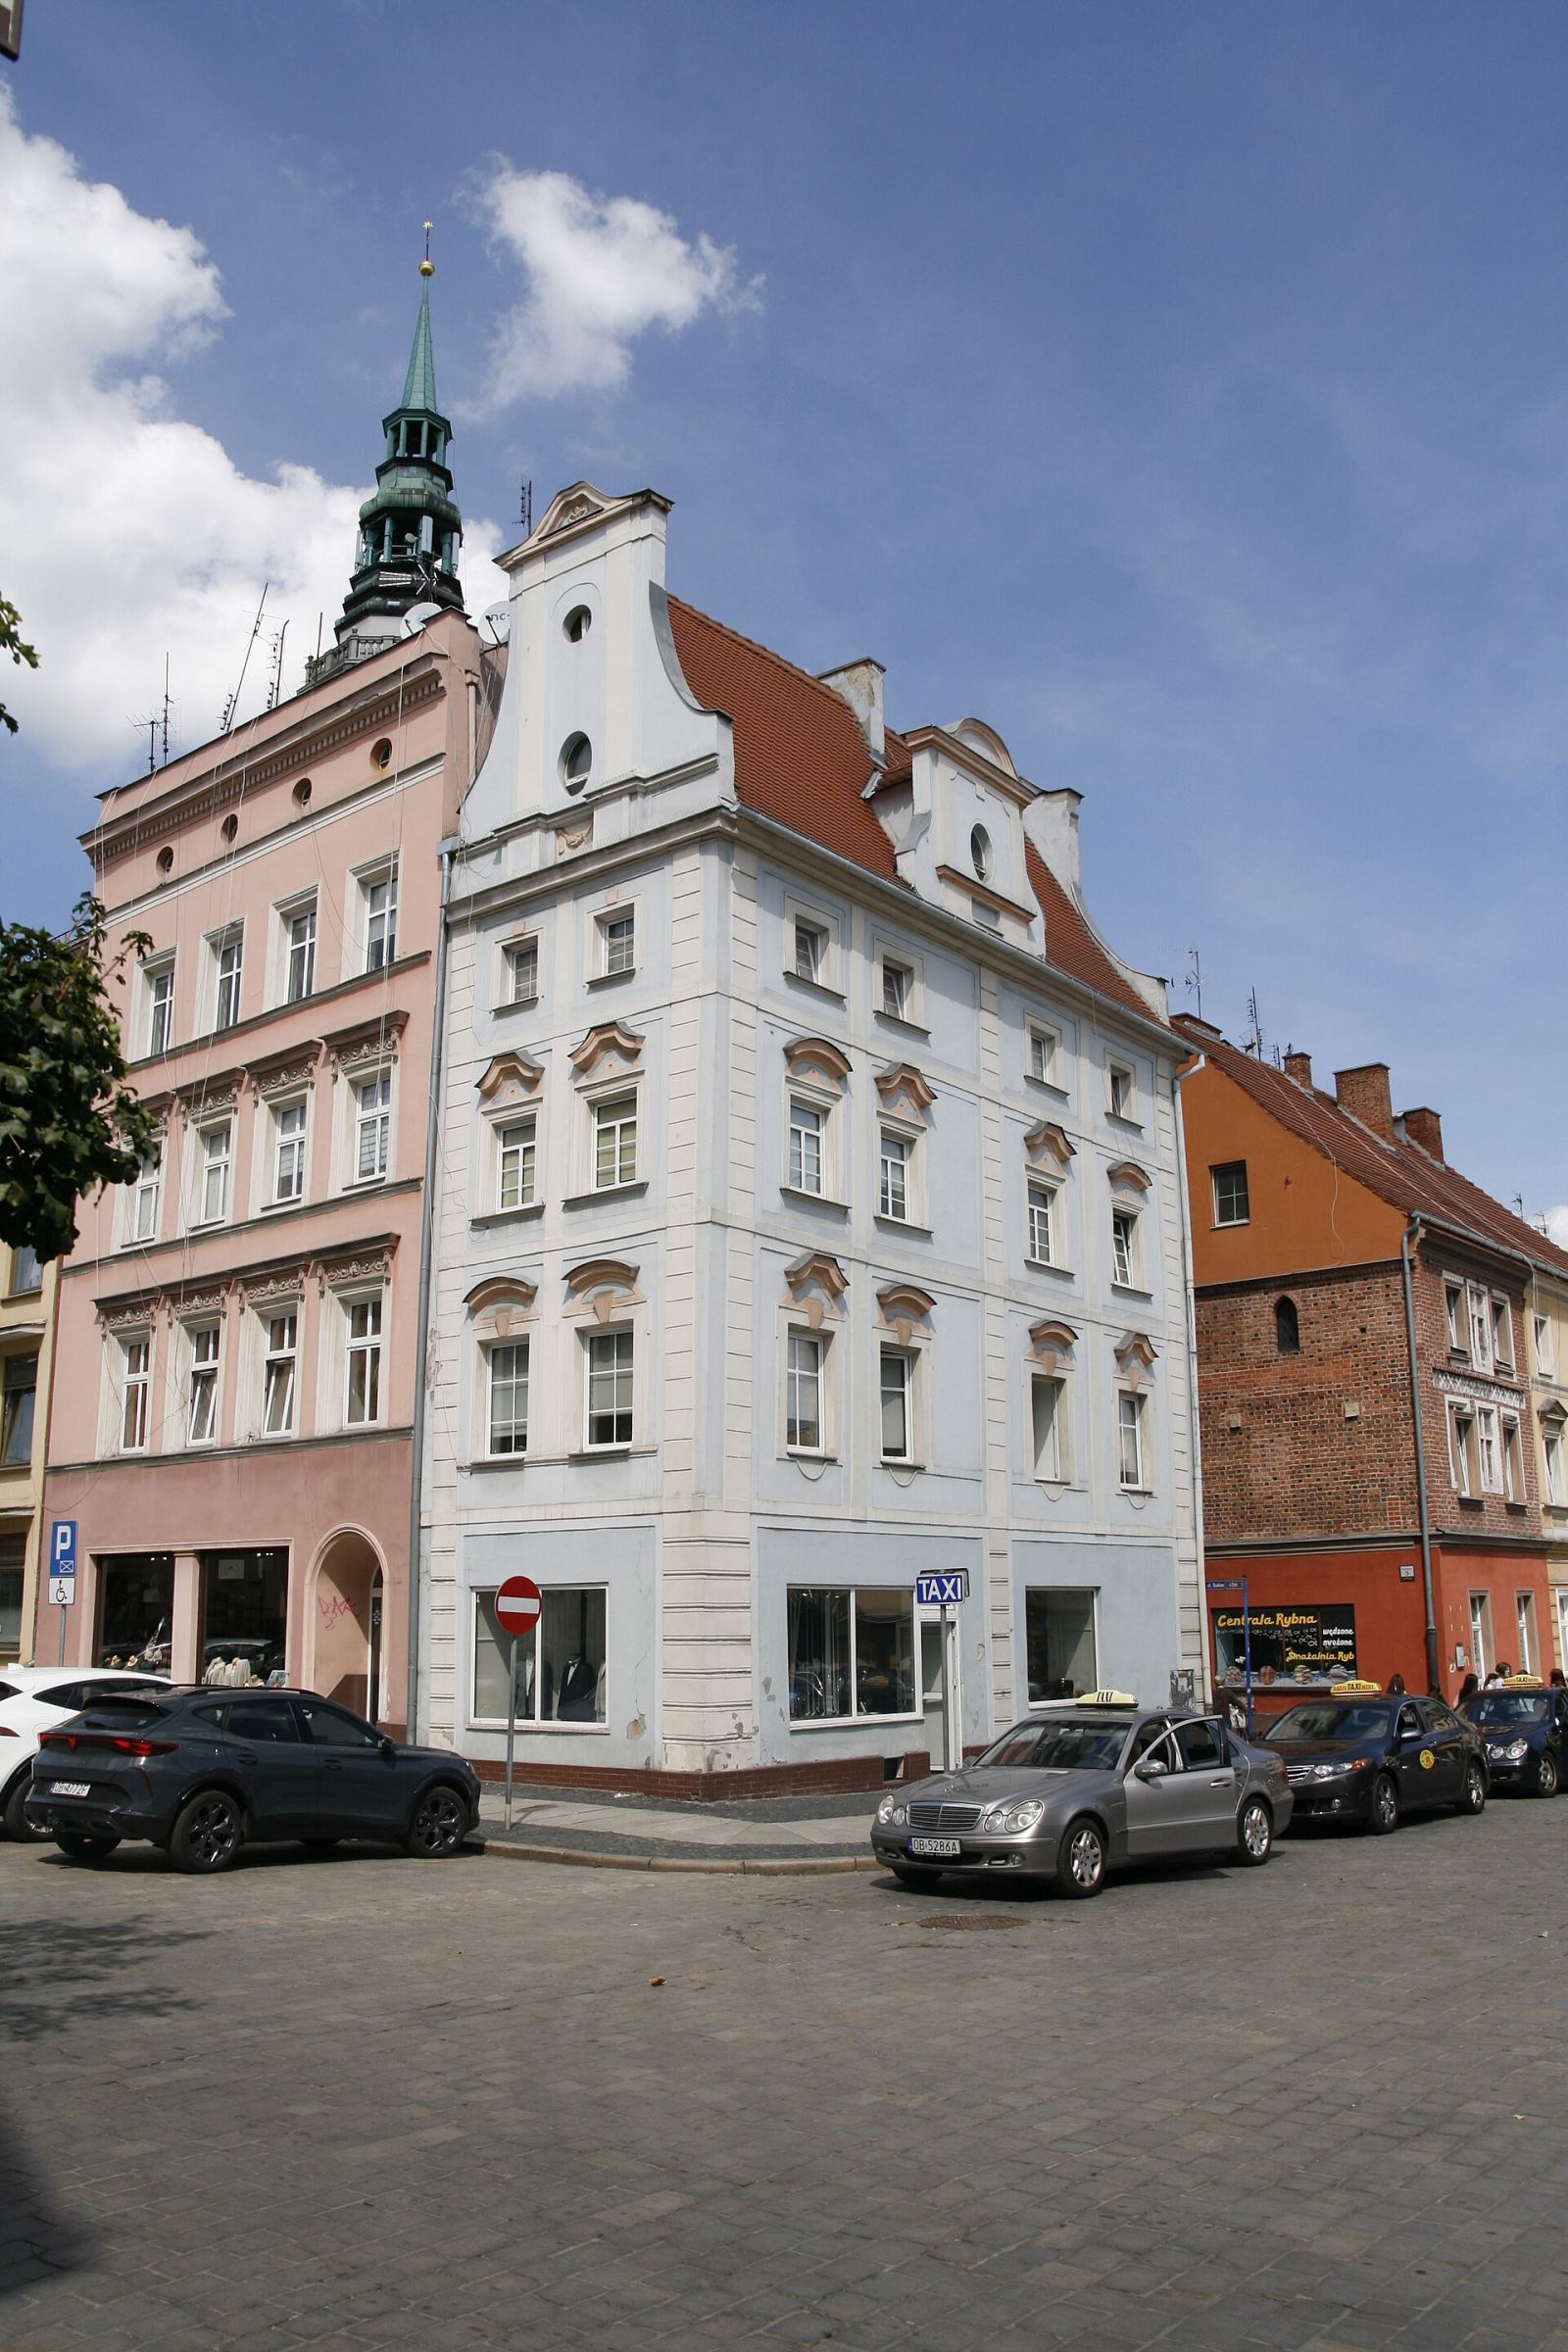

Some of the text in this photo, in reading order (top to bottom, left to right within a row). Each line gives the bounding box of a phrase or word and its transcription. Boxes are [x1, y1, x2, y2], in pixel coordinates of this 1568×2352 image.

[56, 1526, 72, 1560] P
[918, 1578, 961, 1601] TAXI
[1217, 1612, 1317, 1627] Centrala Rybna
[1323, 1627, 1353, 1637] wędzone
[1338, 1650, 1354, 1662] Ryb
[1096, 1690, 1113, 1702] TAXI
[927, 1839, 957, 1852] 5286A
